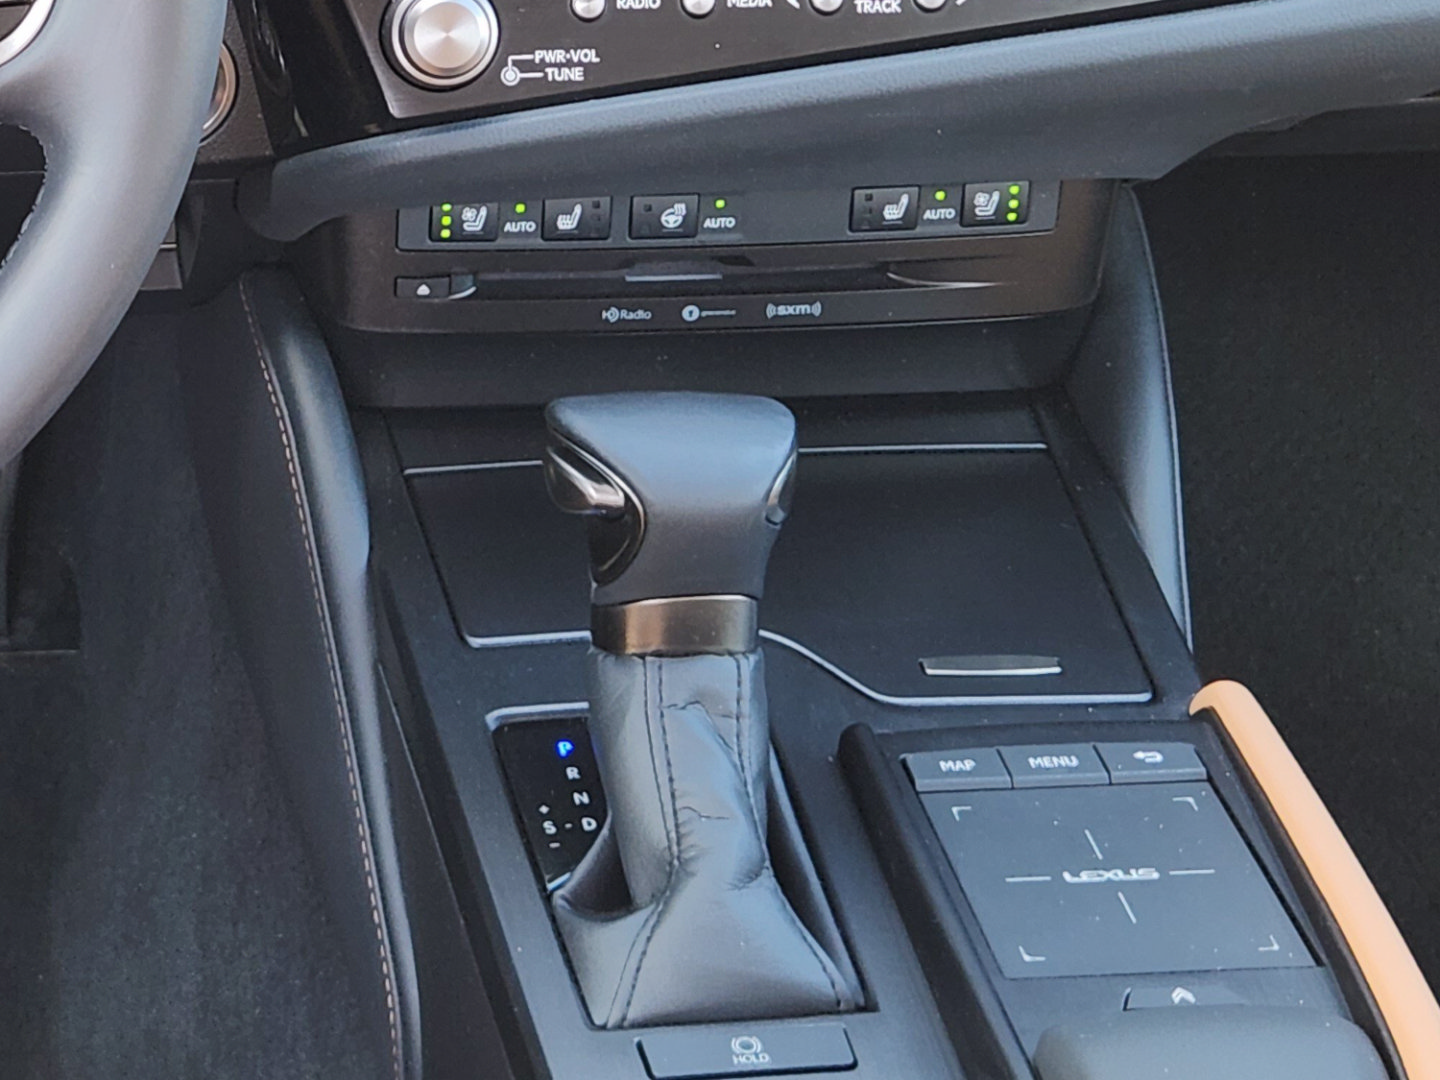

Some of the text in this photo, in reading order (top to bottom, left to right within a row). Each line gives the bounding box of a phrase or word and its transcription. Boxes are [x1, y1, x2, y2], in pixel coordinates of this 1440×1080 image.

[854, 0, 902, 13] TRACK
[544, 67, 584, 82] TUNE
[923, 208, 955, 220] AUTO
[504, 221, 536, 232] AUTO
[703, 217, 736, 229] AUTO
[621, 309, 652, 320] Radio
[557, 740, 573, 757] P
[939, 758, 976, 772] MAP
[1028, 754, 1079, 769] MENU
[565, 766, 581, 780] R
[573, 791, 590, 806] N
[542, 820, 557, 835] S
[581, 817, 597, 832] D
[1062, 867, 1160, 884] LEXUS
[732, 1053, 770, 1064] HOLD
